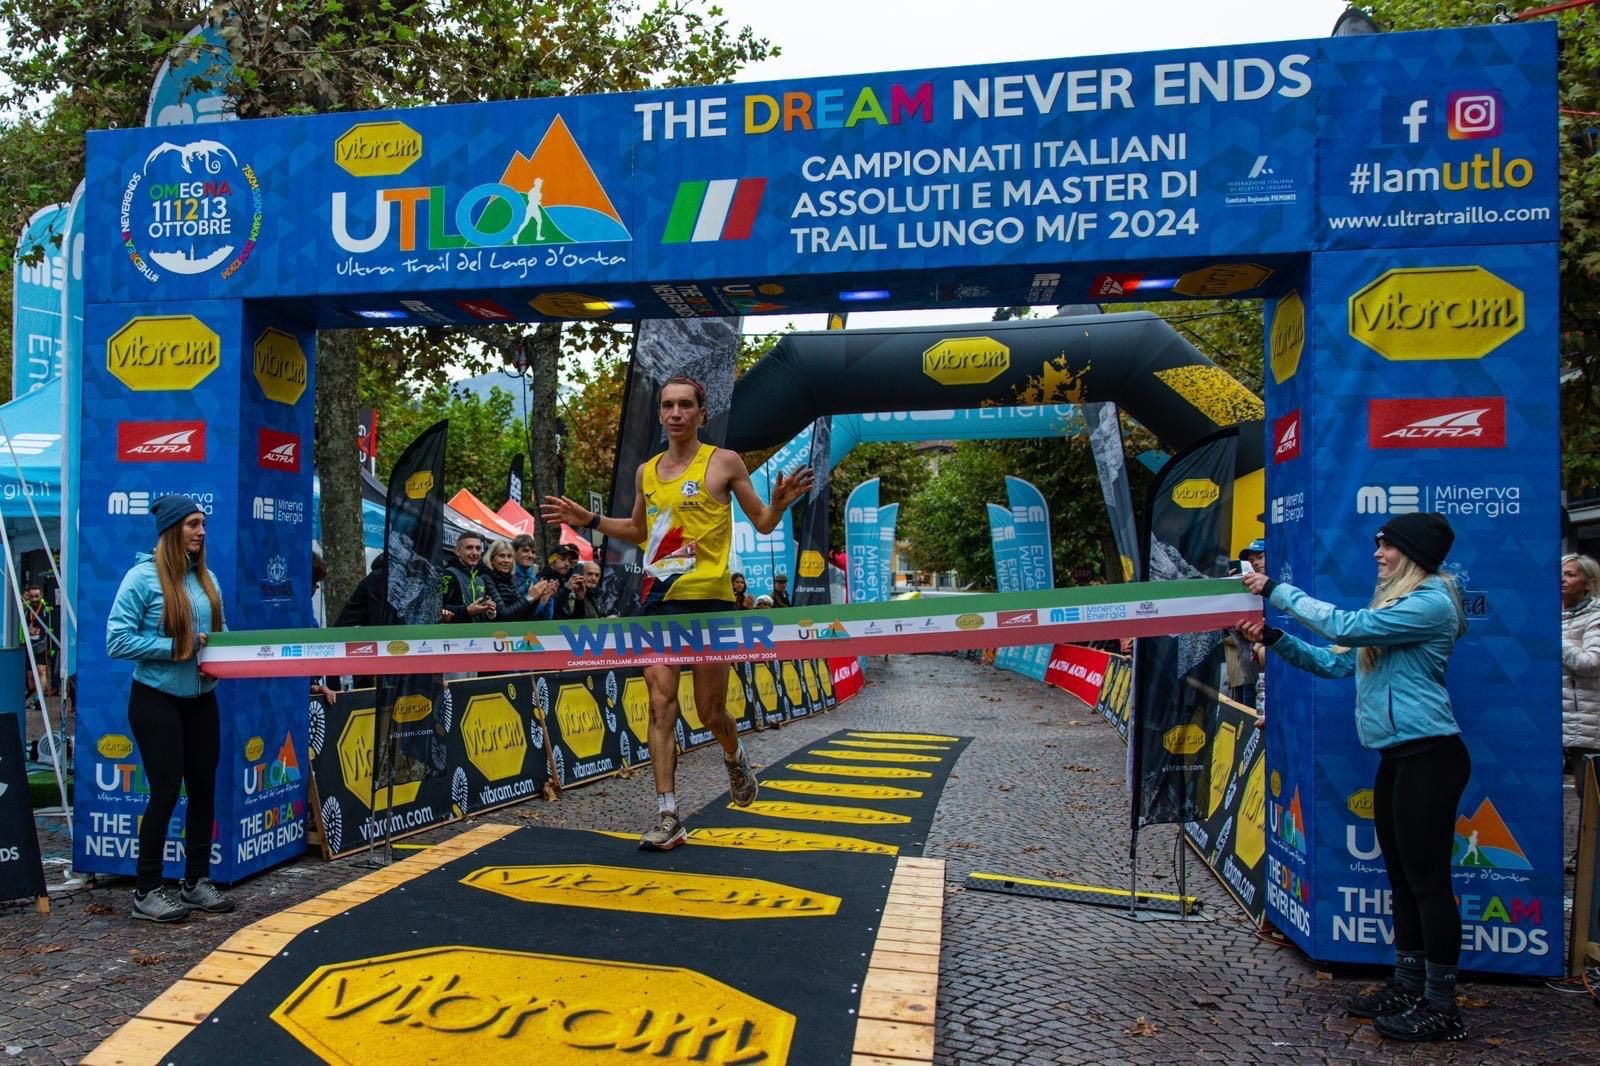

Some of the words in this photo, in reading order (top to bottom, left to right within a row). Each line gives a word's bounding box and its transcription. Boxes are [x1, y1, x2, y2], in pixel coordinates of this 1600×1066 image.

[635, 97, 727, 141] THE
[744, 81, 933, 134] DREAM
[953, 67, 1135, 120] NEVER
[1154, 54, 1312, 106] ENDS
[339, 136, 420, 161] vibram
[802, 144, 1021, 182] CAMPIONATI
[1034, 132, 1187, 169] ITALIANI
[1350, 147, 1533, 194] #Iamutlo
[150, 180, 232, 200] OMEGNA
[791, 182, 959, 219] ASSOLUTI
[971, 181, 992, 209] E
[1003, 172, 1150, 207] MASTER
[1161, 169, 1197, 199] DI
[149, 219, 231, 238] OTTOBRE
[332, 182, 529, 254] UTLO
[790, 225, 888, 254] TRAIL
[898, 217, 1024, 251] LUNGO
[1036, 211, 1098, 244] M/F
[1108, 207, 1200, 240] 2024
[1328, 206, 1550, 230] www.ultratraillo.com
[336, 257, 395, 277] Ultra
[402, 254, 449, 273] Trail
[457, 252, 481, 272] del
[489, 253, 537, 278] Lago
[1359, 291, 1520, 332] vibram
[113, 327, 217, 368] vibram
[928, 343, 1008, 371] vibram
[257, 344, 307, 389] vibram
[1382, 426, 1483, 438] ALTRA
[126, 443, 191, 454] ALTRA
[263, 453, 295, 464] ALTRA
[0, 480, 51, 500] gia.it
[1435, 485, 1520, 500] Minerva
[278, 510, 303, 525] Energia
[279, 499, 304, 512] Minerva
[1435, 499, 1520, 518] Energia
[1086, 604, 1126, 613] Minerva
[1087, 610, 1127, 620] Energia
[559, 615, 776, 658] WINNER
[567, 659, 606, 667] CAMPIONATI
[633, 657, 664, 666] ASSOLUTI
[669, 656, 695, 664] MASTER
[760, 652, 778, 660] 2024
[95, 763, 150, 794] UTL
[572, 757, 613, 779] vibram.com
[479, 778, 536, 806] vibram.com
[1352, 795, 1373, 809] vib
[89, 811, 131, 835] THE
[240, 811, 263, 836] THE
[264, 800, 304, 831] DREAM
[85, 835, 140, 859] NEVE
[237, 833, 275, 865] NEVER
[276, 818, 304, 848] ENDS
[1268, 854, 1282, 886] THE
[500, 870, 826, 912] vibram
[1267, 879, 1289, 921] NEVER
[1289, 899, 1311, 938] ENDS
[1454, 894, 1543, 926] EAM
[321, 972, 769, 1065] vibram
